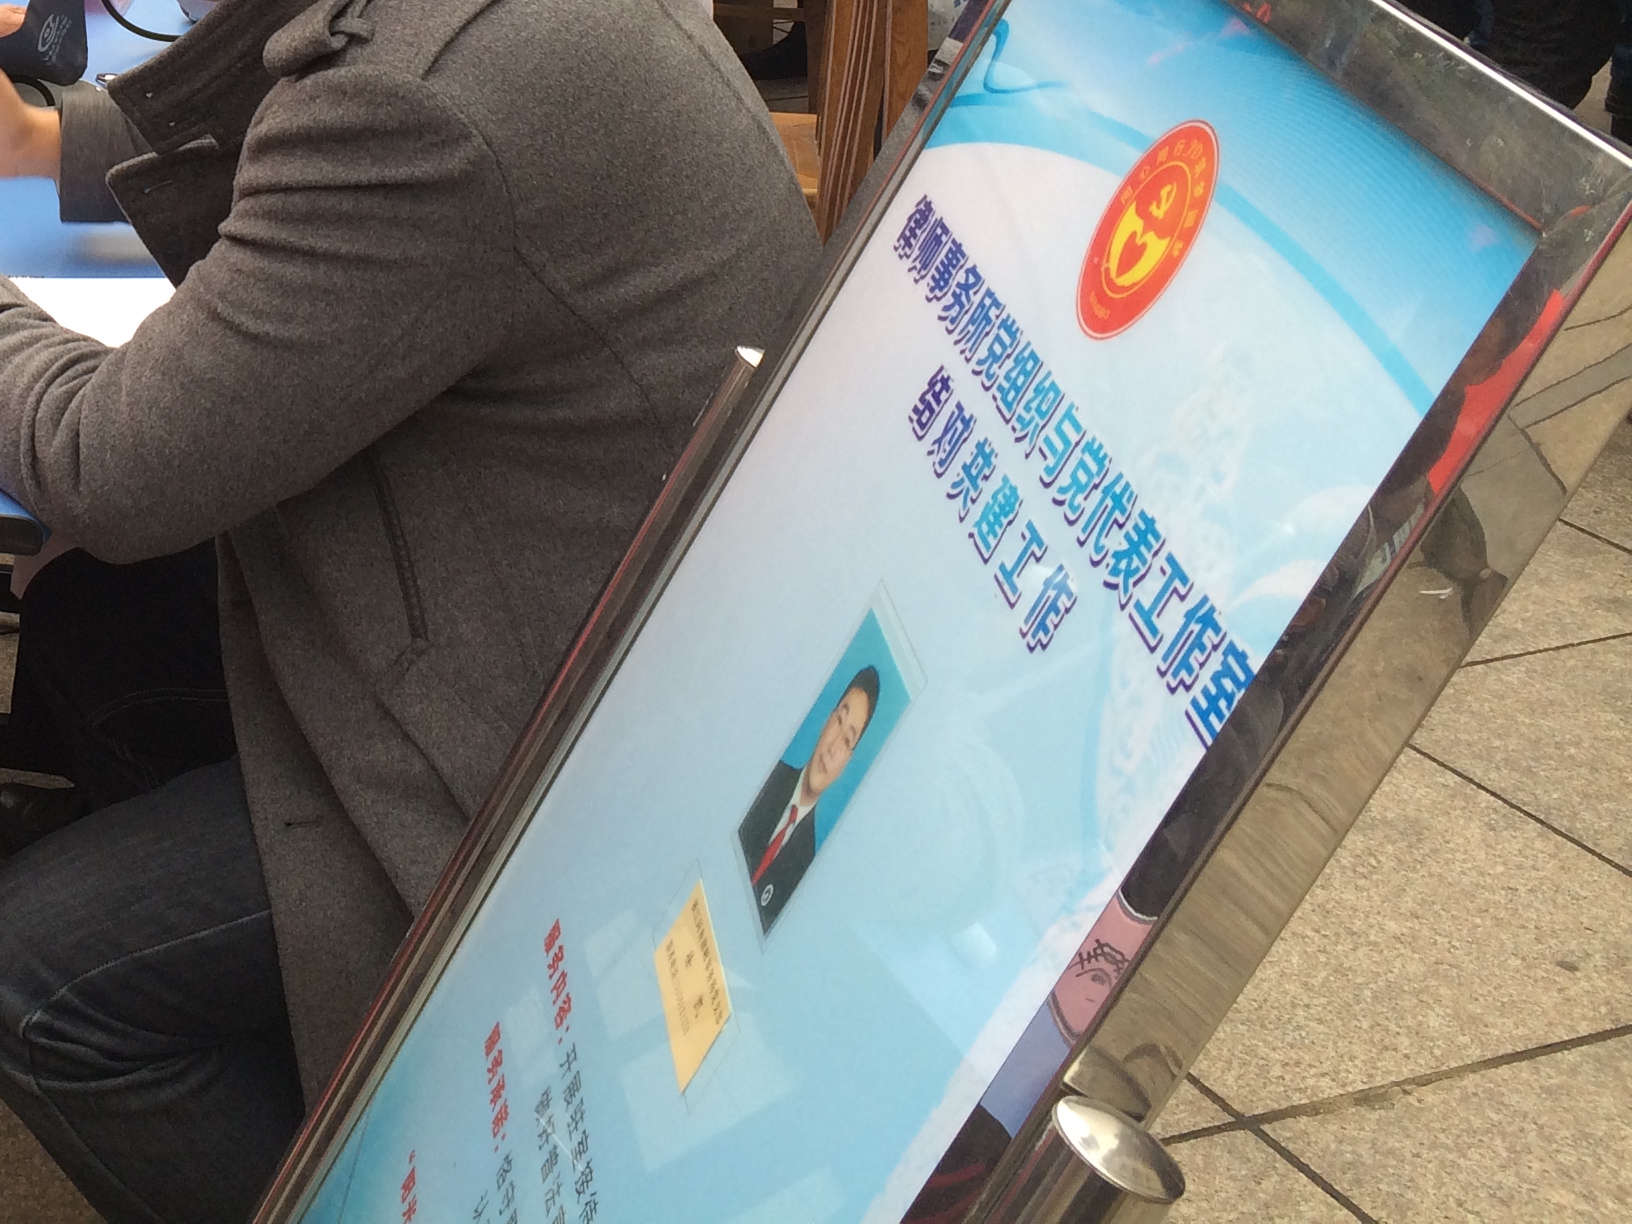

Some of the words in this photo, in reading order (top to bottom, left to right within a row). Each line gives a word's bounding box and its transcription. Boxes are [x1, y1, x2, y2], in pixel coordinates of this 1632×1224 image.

[892, 193, 1255, 750] 律师事务所党组织与党代表工作室
[908, 364, 1078, 654] 结对共建工作
